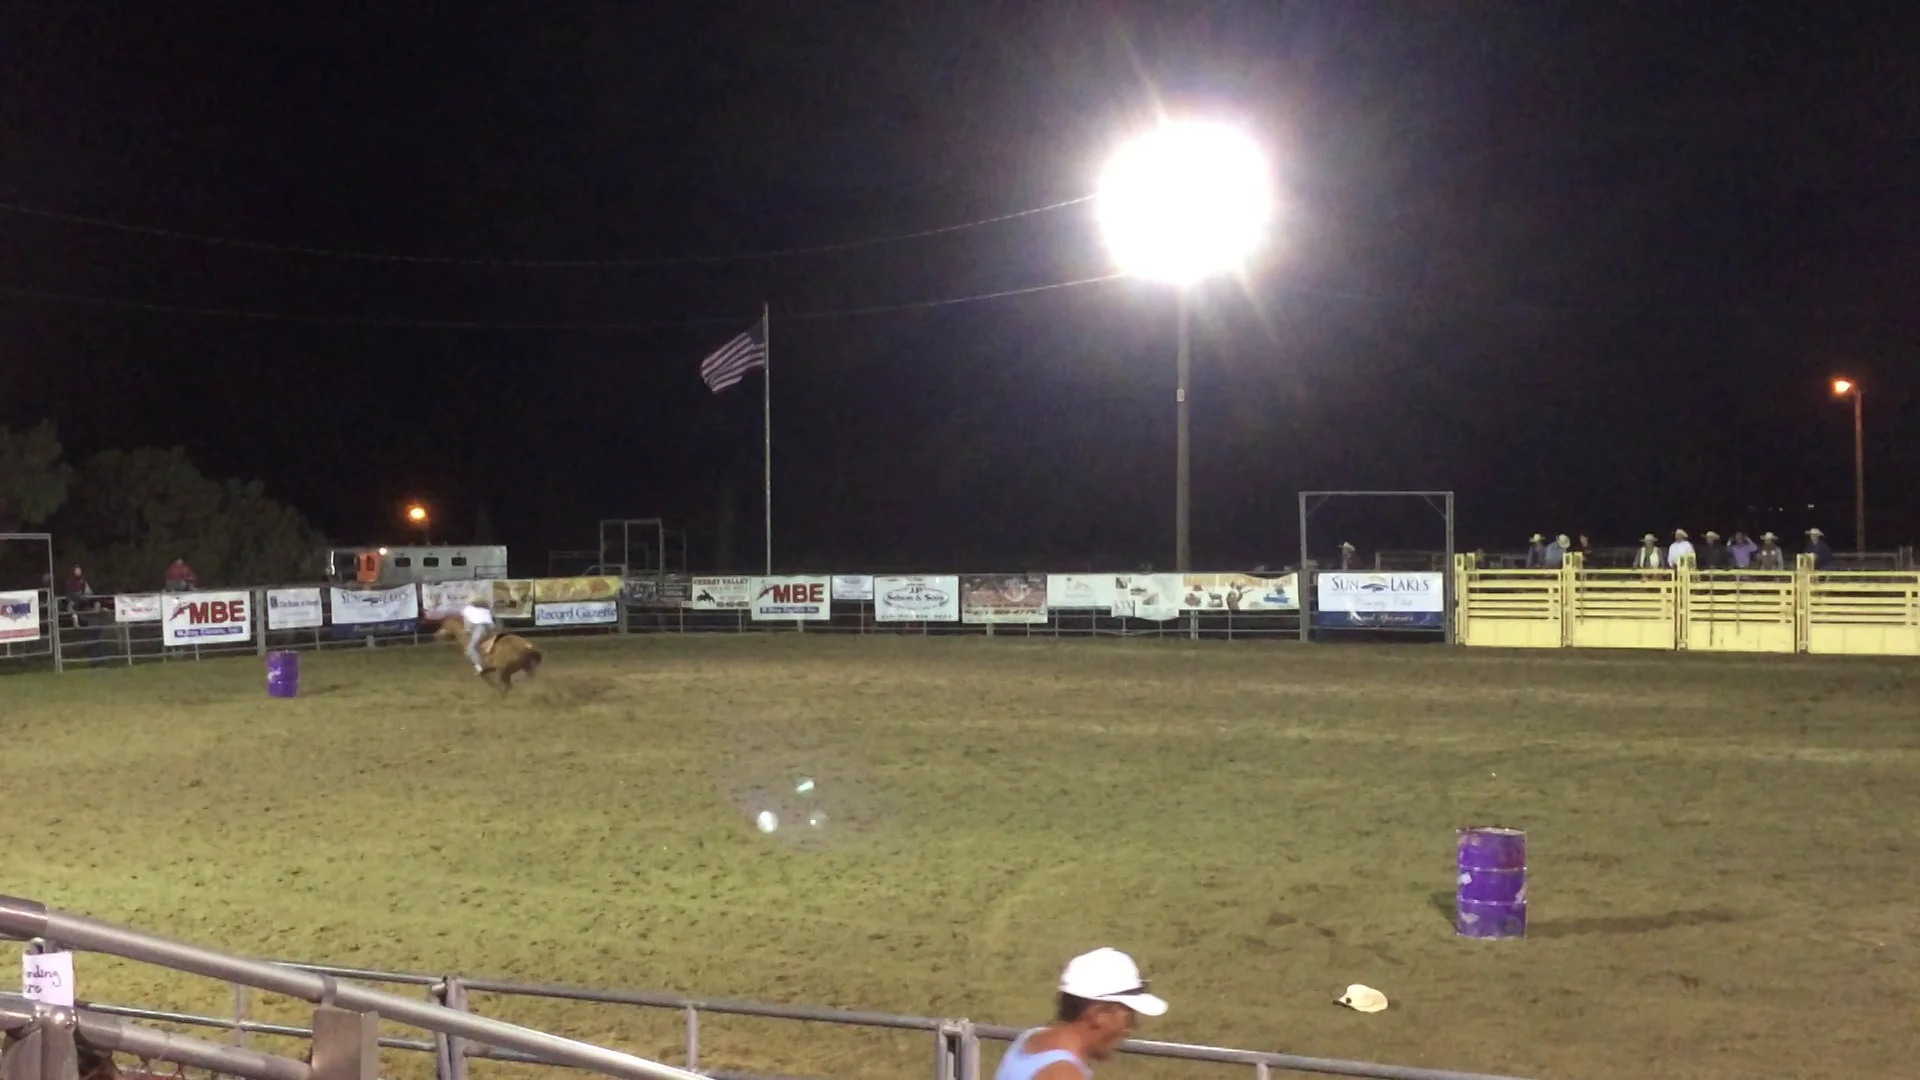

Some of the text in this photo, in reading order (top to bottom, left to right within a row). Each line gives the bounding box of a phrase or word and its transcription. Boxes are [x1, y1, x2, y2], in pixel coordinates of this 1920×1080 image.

[1331, 575, 1430, 592] SUN LAKES
[772, 583, 825, 604] MBE
[189, 600, 246, 625] MBE
[537, 602, 617, 620] Record Gazette
